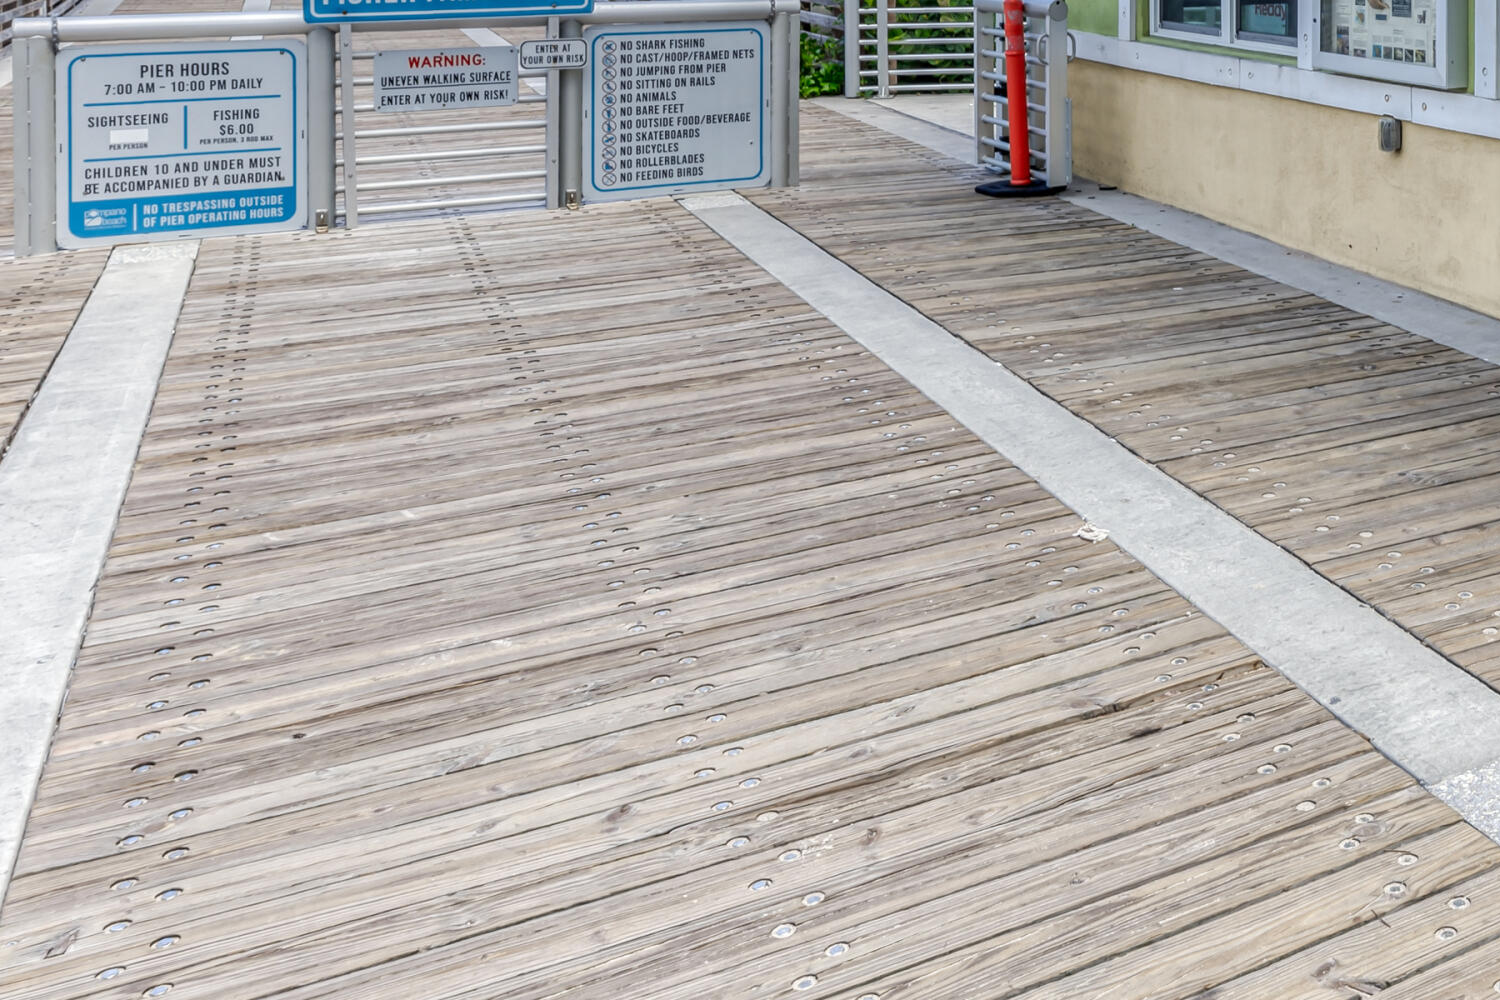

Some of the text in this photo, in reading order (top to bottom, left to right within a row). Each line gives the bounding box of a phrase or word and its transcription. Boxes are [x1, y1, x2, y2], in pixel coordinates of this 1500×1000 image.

[536, 44, 571, 54] ENTER AT
[620, 38, 705, 50] NO SHARK FISHING
[408, 54, 486, 69] WARNING:
[522, 53, 584, 65] YOUR OWN RISK
[620, 49, 754, 64] NO CAST/HOOP/FRAMED NETS
[140, 62, 230, 78] PIER HOURS
[620, 62, 726, 77] NO JUMPING FROM PIER
[380, 70, 512, 88] UNEVEN WALKING SURFACE
[620, 76, 716, 90] NO SITTING ON RAILS
[104, 84, 133, 96] 7:00
[136, 82, 156, 94] AM
[170, 80, 205, 92] 10:00
[210, 80, 227, 91] PM
[231, 78, 264, 90] DAILY
[381, 89, 509, 106] ENTER AT YOUR OWN RISK!
[620, 91, 677, 103] NO ANIMALS
[213, 108, 260, 121] FISHING
[620, 104, 684, 116] NO BARE FEET
[88, 112, 168, 128] SIGHTSEEING
[620, 112, 752, 130] NO OUTSIDE FOOD/BEVERAGE
[219, 124, 254, 136] $6.00
[620, 128, 700, 142] NO SKATEBOARDS
[261, 134, 274, 142] MAX
[123, 142, 148, 150] PERSON
[620, 142, 679, 156] NO BICYCLES
[84, 156, 282, 180] CHILDREN 10 AND UNDER MUST
[620, 154, 705, 168] NO ROLLERBLADES
[620, 166, 704, 182] NO FEEDING BIRDS
[84, 183, 100, 195] BE
[104, 176, 190, 194] ACCOMPANIED
[194, 175, 208, 188] BY
[212, 174, 220, 186] A
[143, 194, 284, 215] NO TRESPASSING OUTSIDE
[102, 216, 127, 226] beach
[143, 207, 284, 228] OF PIER OPERATING HOURS
